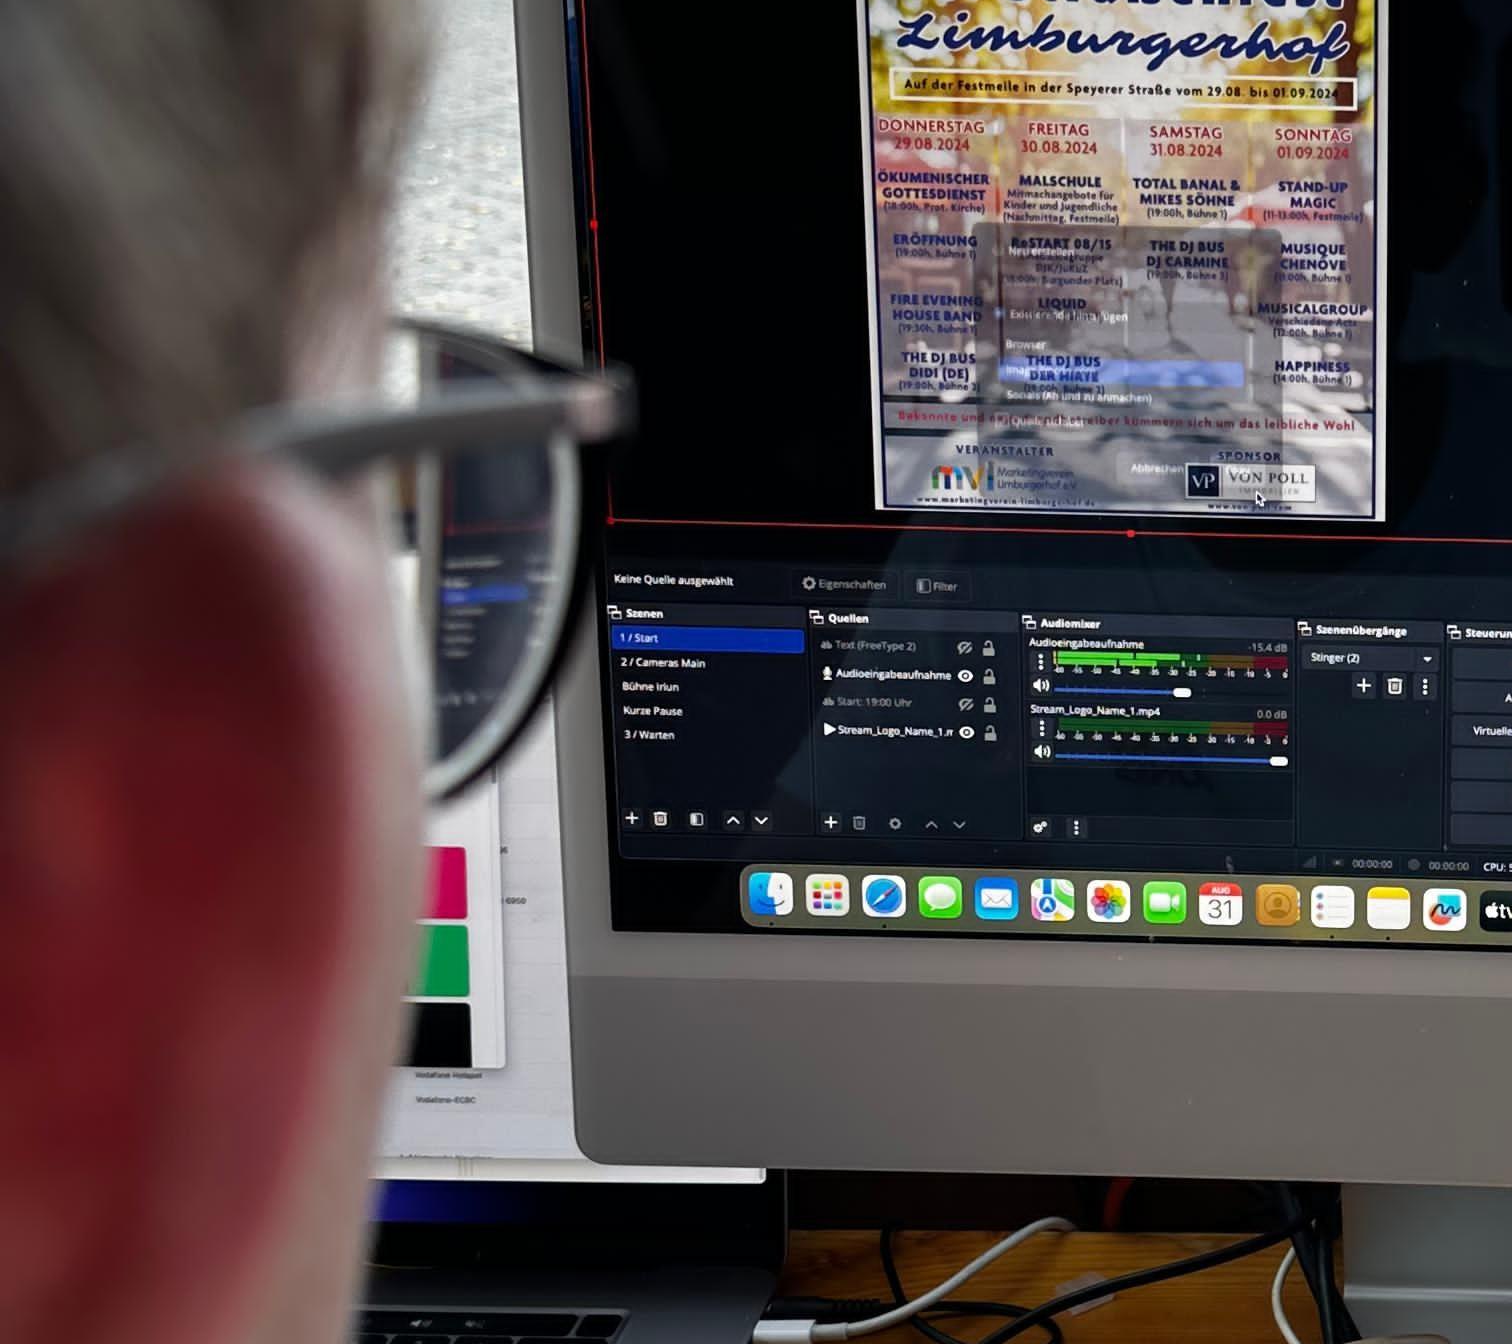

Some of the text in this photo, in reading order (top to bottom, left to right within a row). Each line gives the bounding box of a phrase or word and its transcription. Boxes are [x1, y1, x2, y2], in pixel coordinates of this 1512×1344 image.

[896, 12, 1351, 75] Limburgerhof
[614, 574, 733, 588] Keine Quelle ausgewählt
[626, 608, 664, 620] Szenen
[828, 613, 869, 625] Quellen
[1041, 618, 1101, 630] Audiomixer
[1316, 625, 1408, 638] Szenenübergänge
[1029, 638, 1144, 651] Audioeingabeaufnahme
[1030, 704, 1161, 718] Stream_Logo_Name_1.mp4
